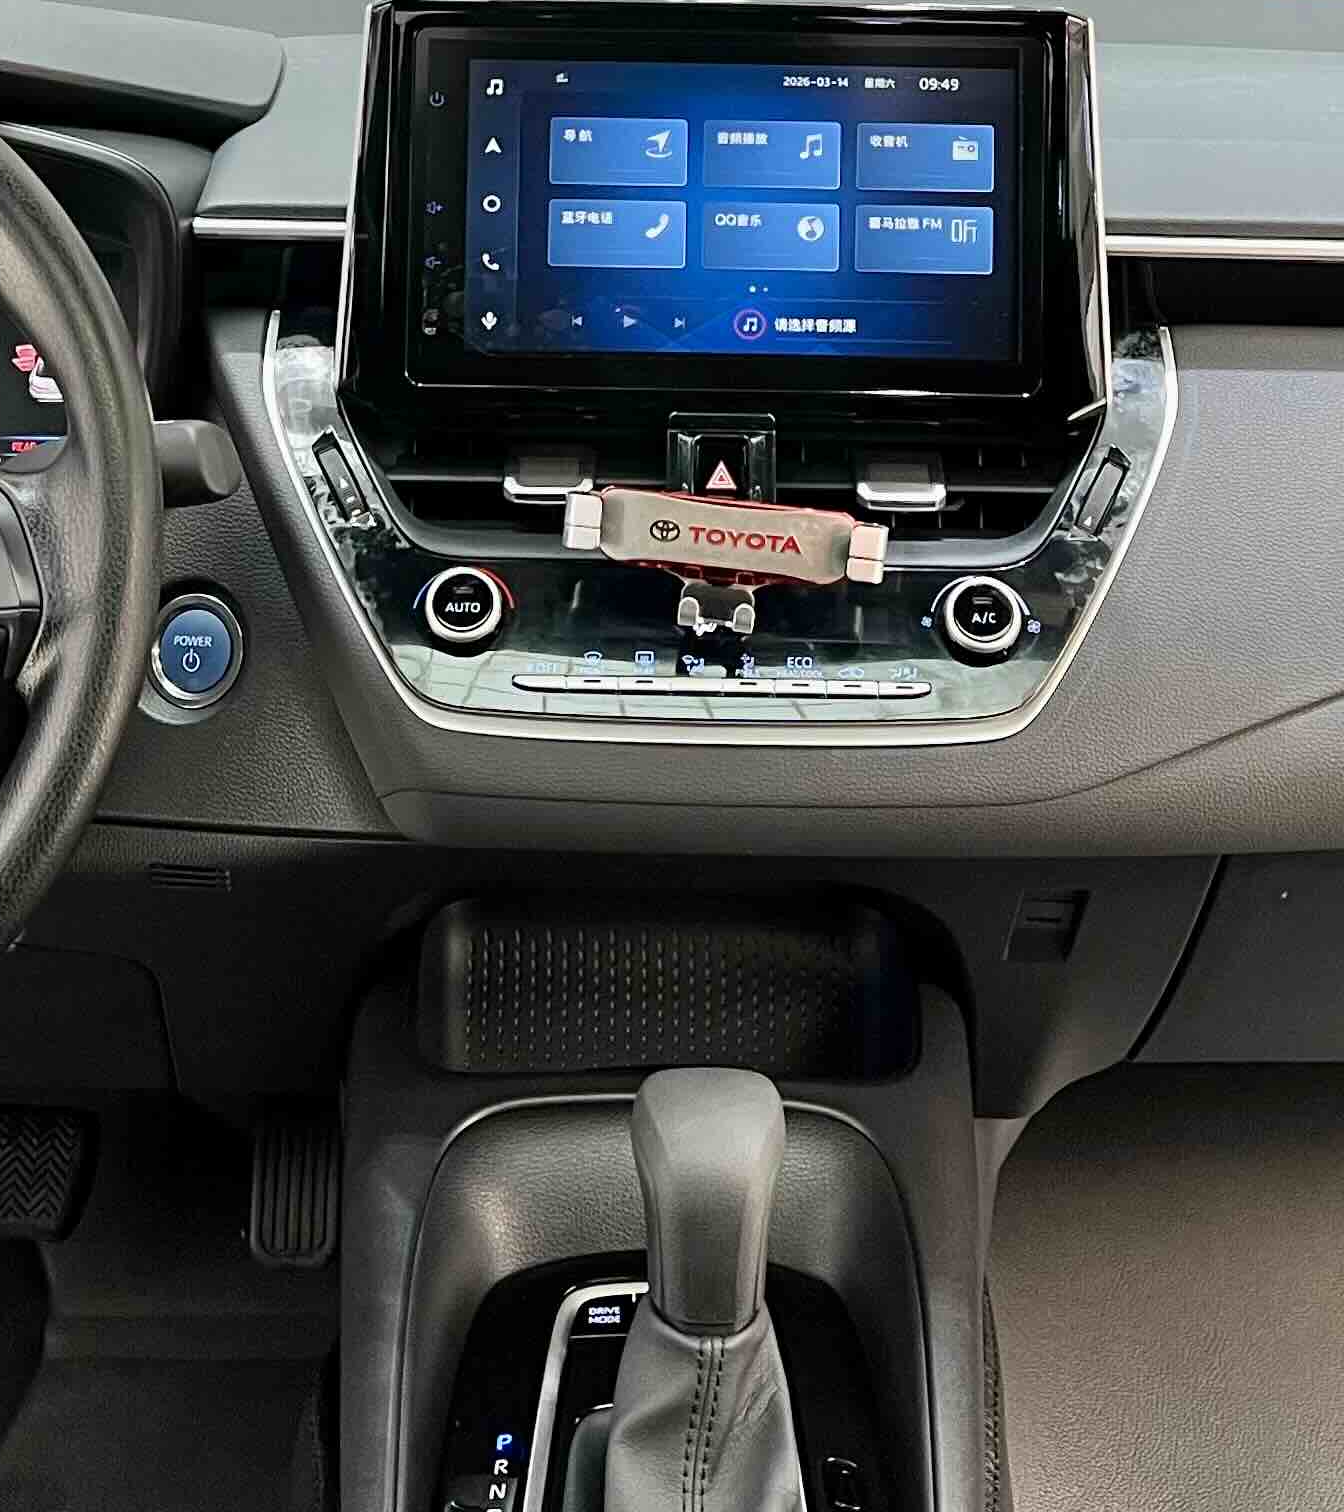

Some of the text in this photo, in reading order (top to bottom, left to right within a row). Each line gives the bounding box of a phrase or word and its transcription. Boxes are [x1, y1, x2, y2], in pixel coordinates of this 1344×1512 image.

[783, 76, 849, 88] 2026-03-14
[918, 77, 960, 91] 09:49
[563, 129, 593, 143] 导航
[869, 135, 908, 149] 收音机
[714, 214, 762, 228] QQ音乐
[923, 218, 943, 231] FM
[688, 525, 802, 554] TOYOTA
[444, 601, 481, 613] AUTO
[971, 612, 997, 624] A/C
[173, 635, 212, 647] POWER
[787, 656, 814, 669] ECO
[588, 1306, 620, 1316] DRIVE
[588, 1315, 621, 1324] MODE
[496, 1433, 513, 1451] P
[493, 1458, 509, 1476] R
[488, 1482, 507, 1500] N
